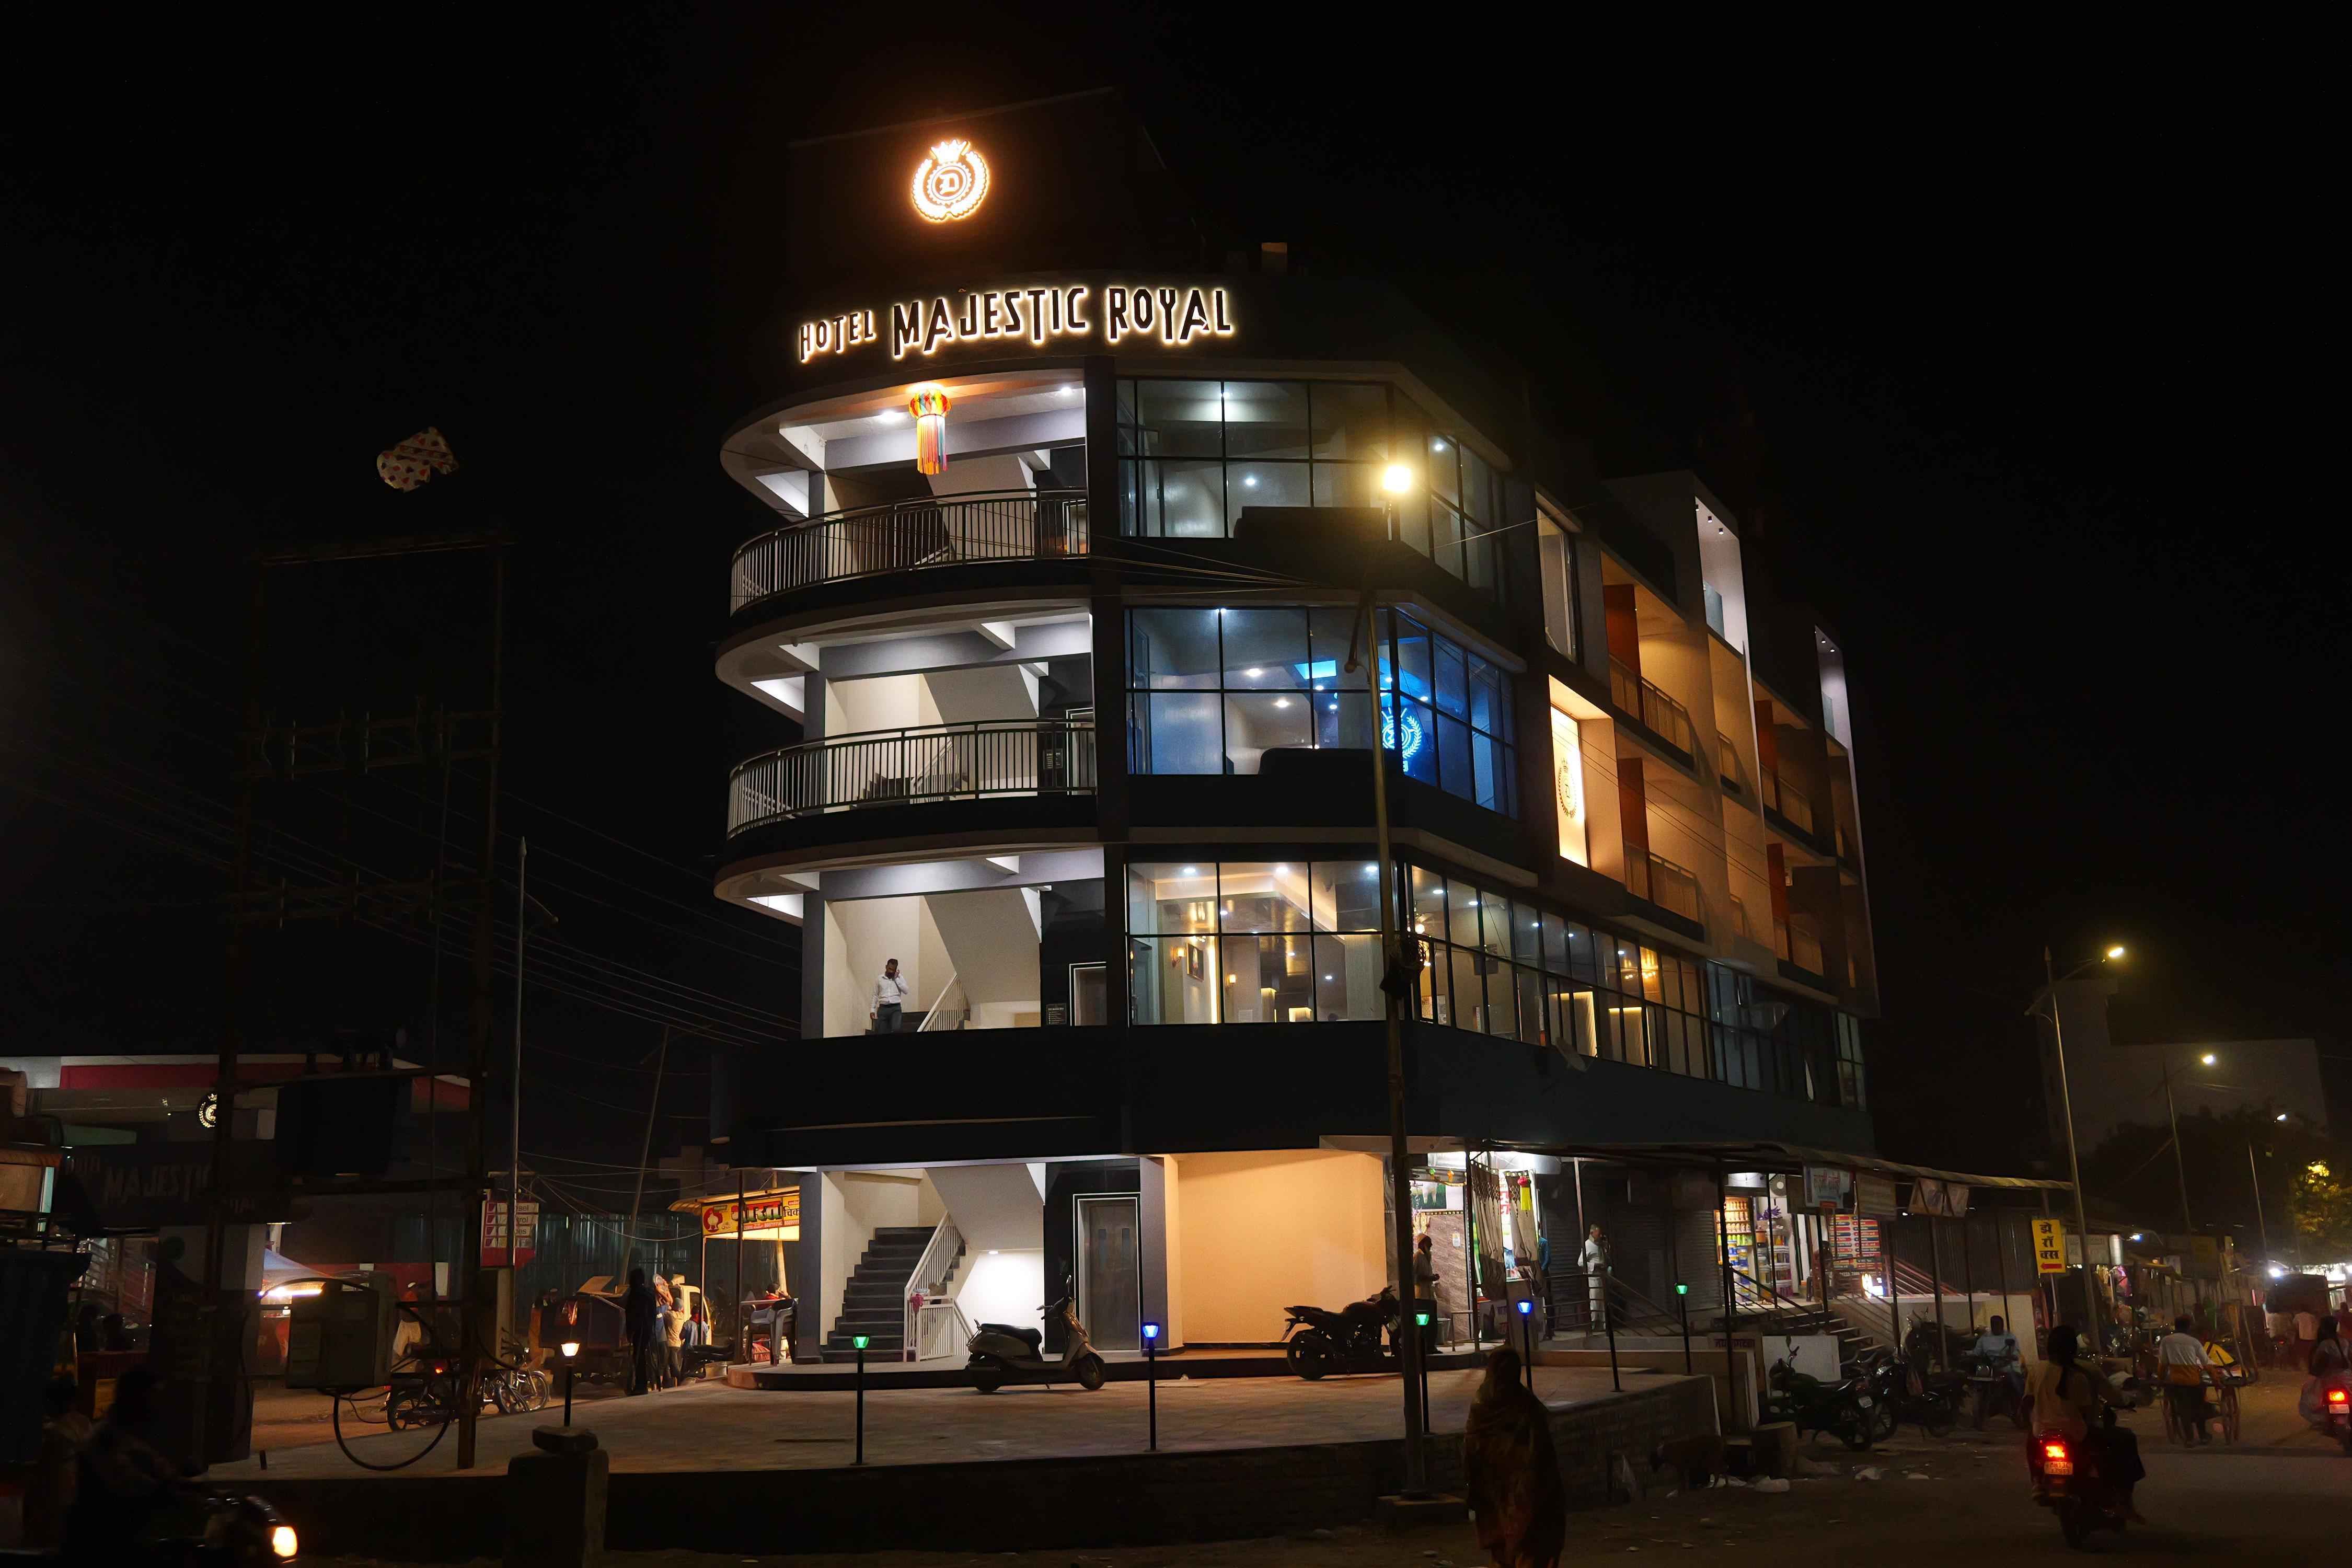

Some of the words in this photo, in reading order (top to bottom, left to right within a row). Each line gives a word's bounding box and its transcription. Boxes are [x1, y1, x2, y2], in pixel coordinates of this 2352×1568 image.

[800, 311, 875, 362] HOTEL
[893, 287, 1089, 359] MAJESTIC
[1108, 287, 1232, 343] ROYAL
